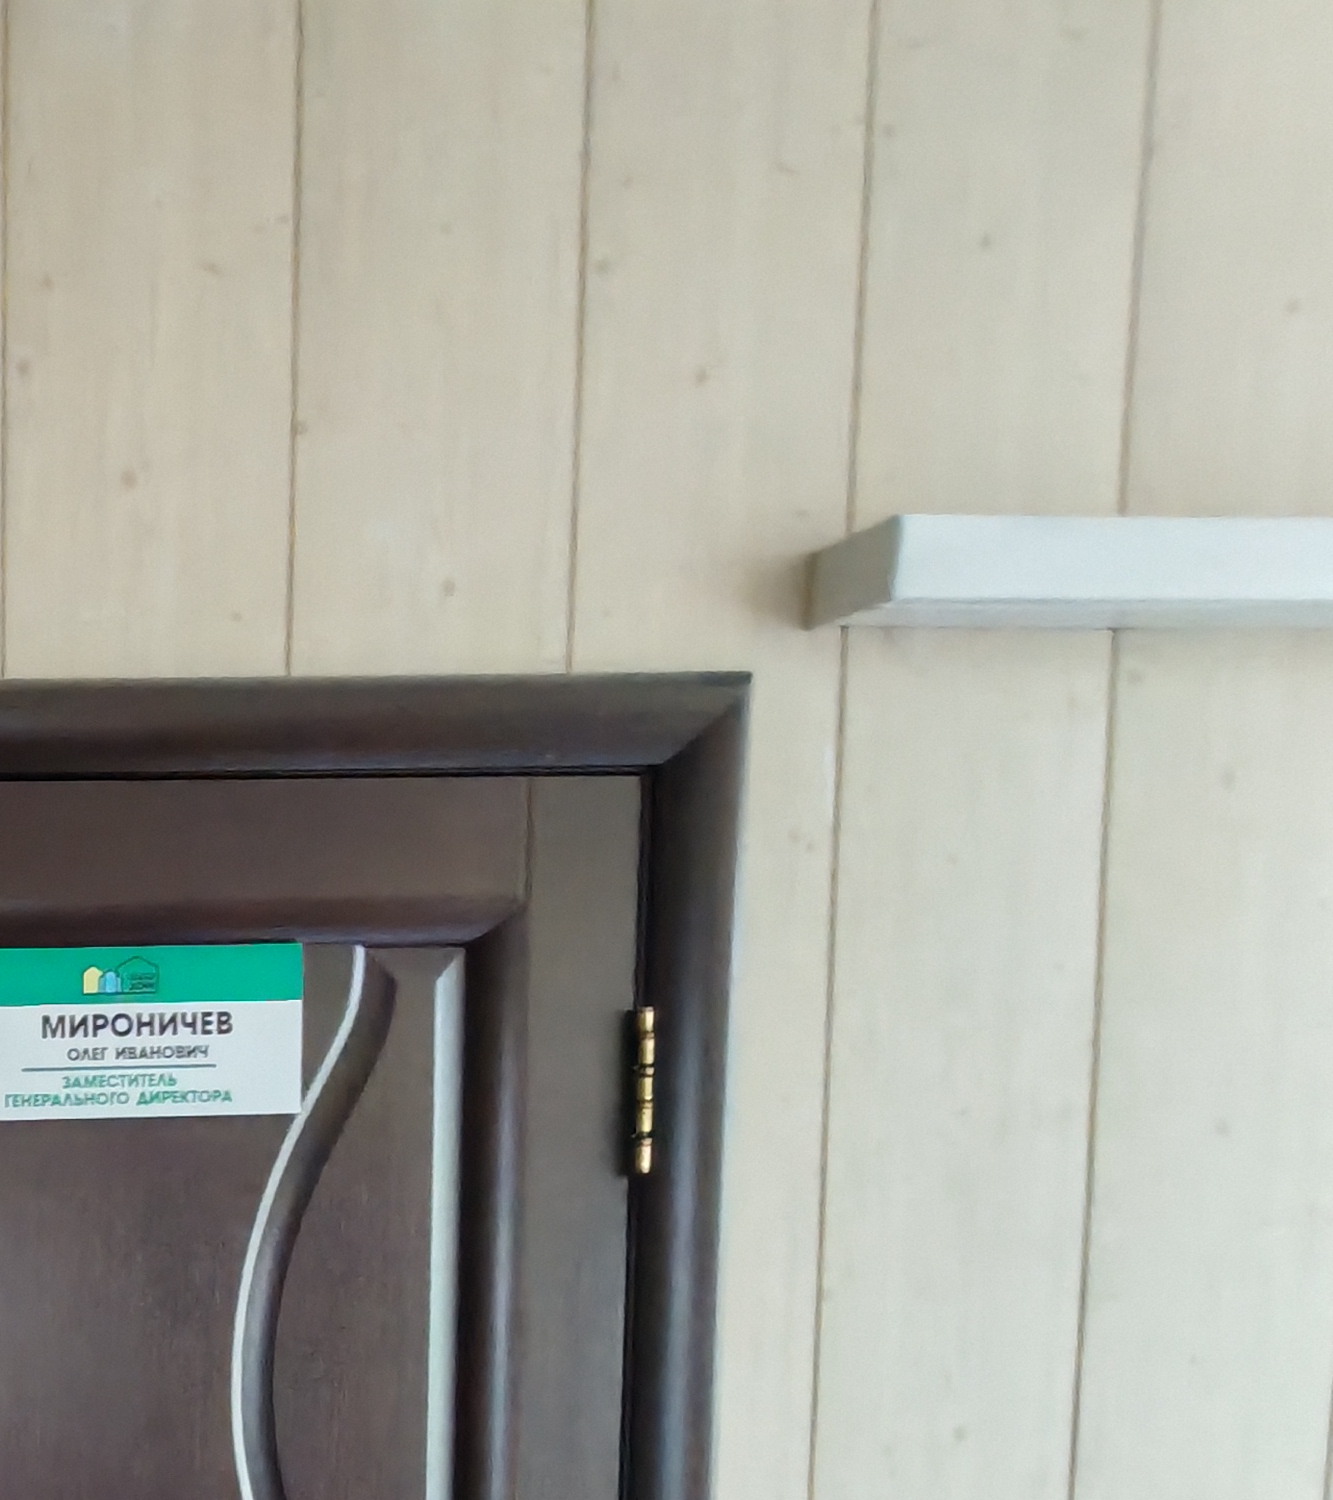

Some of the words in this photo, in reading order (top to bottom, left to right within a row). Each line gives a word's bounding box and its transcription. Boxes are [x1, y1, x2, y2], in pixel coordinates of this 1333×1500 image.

[41, 1011, 234, 1039] МИРОНИЧЕВ
[67, 1046, 109, 1062] ОЛЕГ
[114, 1044, 210, 1061] ИВАНОВИЧ
[62, 1072, 178, 1089] ЗАМЕСТИТЕЛЬ
[4, 1091, 130, 1108] ГЕНЕРАЛЬНОГО
[136, 1089, 233, 1106] ДИРЕКТОРА
